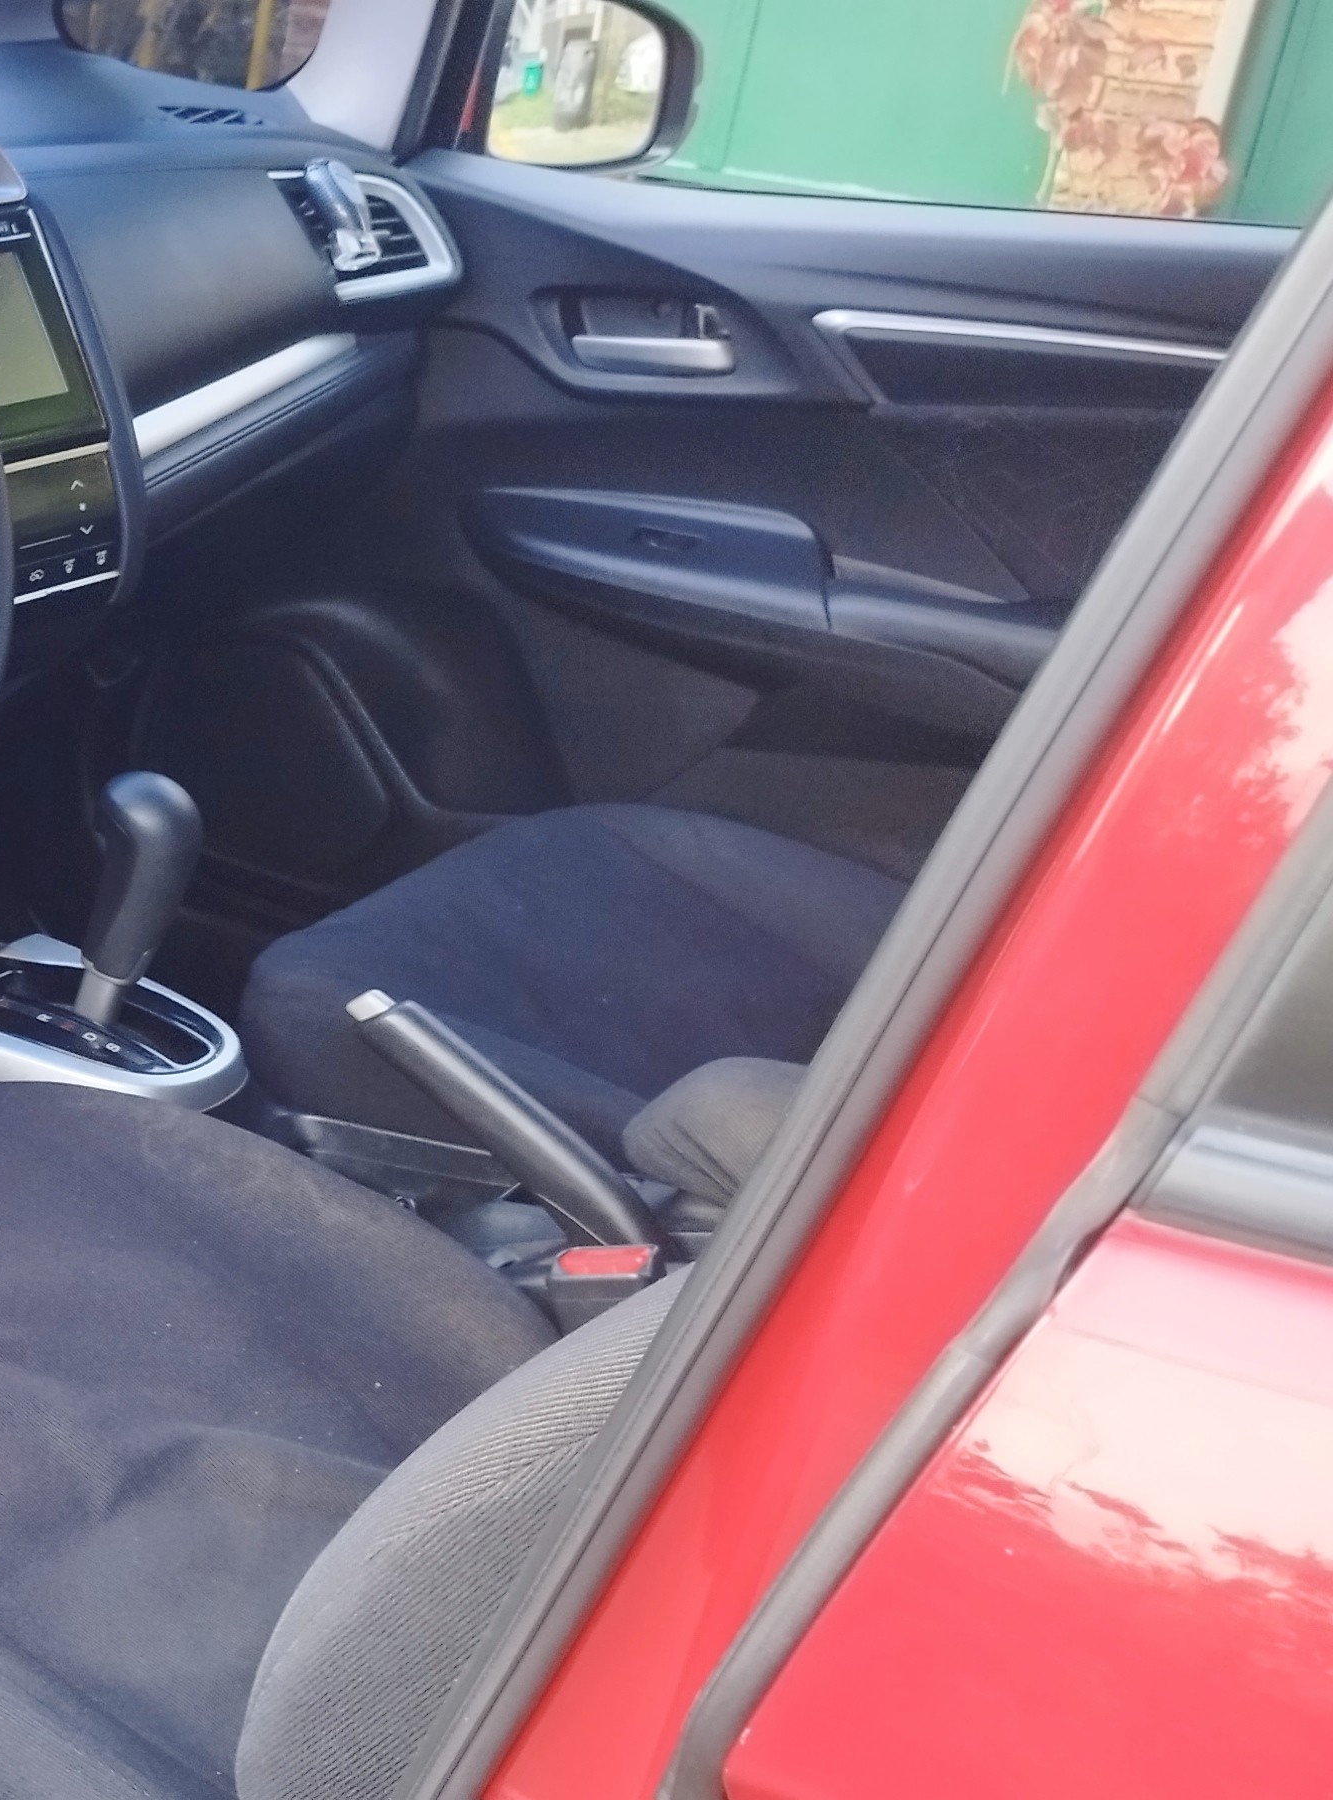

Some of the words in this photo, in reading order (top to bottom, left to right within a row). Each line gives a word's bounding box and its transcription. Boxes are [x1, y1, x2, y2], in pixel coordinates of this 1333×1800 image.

[36, 1013, 53, 1023] R
[81, 1031, 98, 1041] D
[105, 1042, 121, 1053] S
